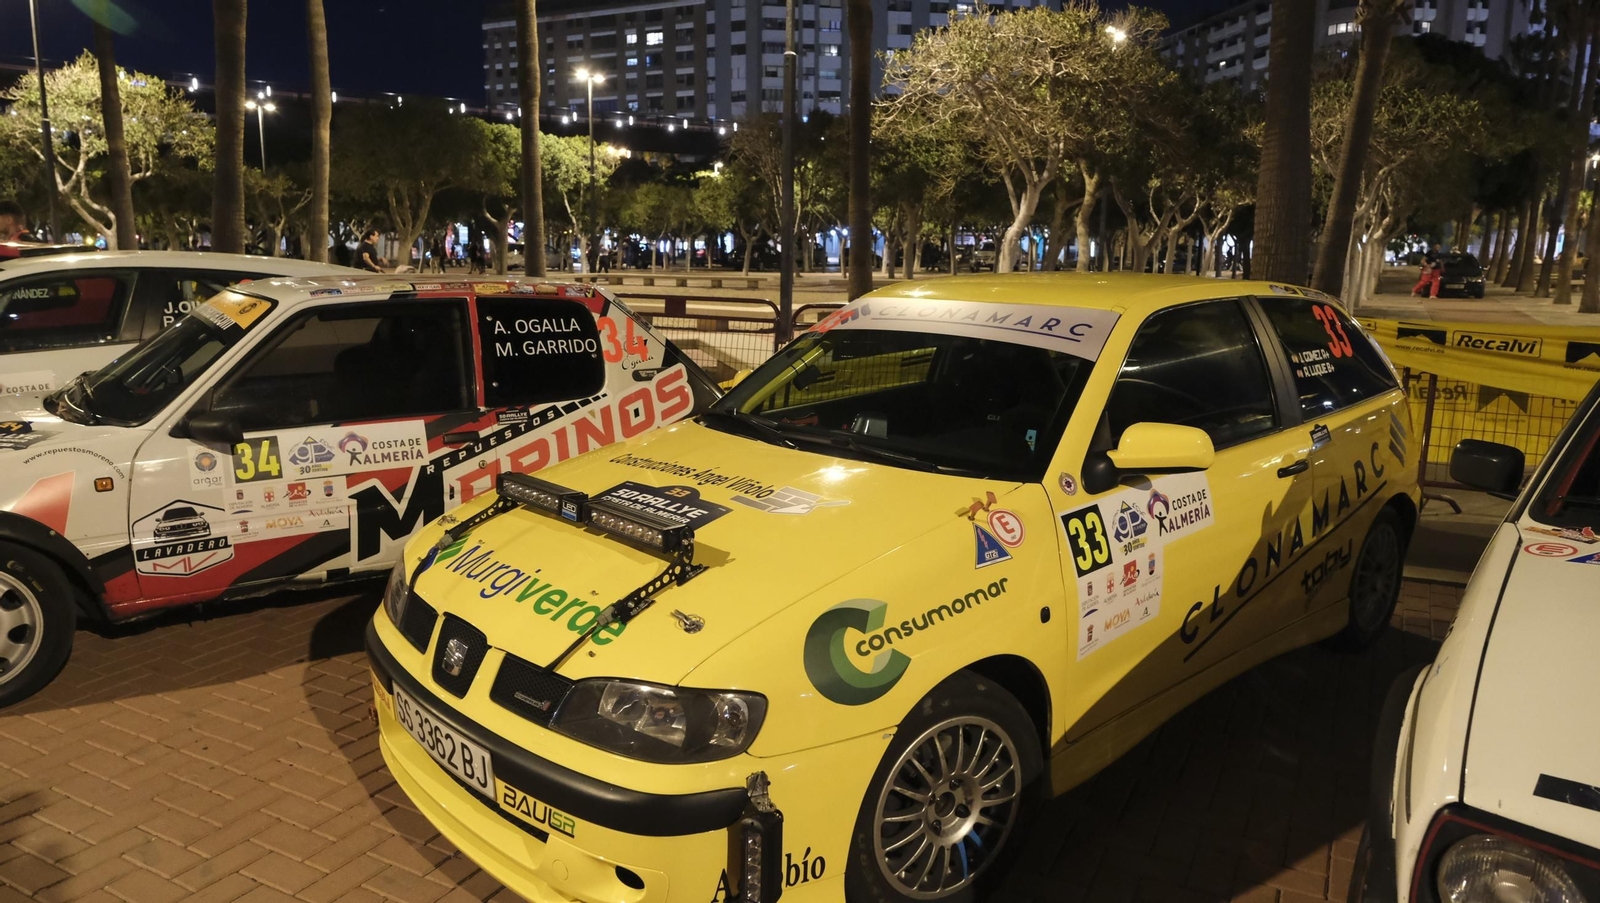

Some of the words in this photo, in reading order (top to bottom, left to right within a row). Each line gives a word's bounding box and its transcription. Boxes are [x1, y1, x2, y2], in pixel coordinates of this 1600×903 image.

[494, 320, 511, 335] A.
[515, 318, 581, 334] OGALLA
[877, 303, 1094, 337] CLONAMARC
[1312, 304, 1353, 358] 33
[495, 341, 519, 357] M.
[523, 338, 597, 356] GARRIDO
[597, 316, 649, 363] 34
[1456, 334, 1538, 355] Recalvi
[6, 384, 37, 394] COSTA
[38, 383, 50, 391] DE
[372, 440, 406, 450] COSTA
[409, 438, 422, 446] DE
[426, 410, 555, 475] REPUESTOS
[23, 447, 125, 480] www.repuestosmoreno.com
[233, 440, 281, 480] 34
[363, 446, 424, 465] ALMERÍA
[609, 452, 698, 477] Construcciones
[193, 476, 222, 487] argar
[299, 465, 311, 475] 30
[664, 486, 692, 498] 33
[1172, 494, 1198, 511] COSTA
[1197, 488, 1208, 500] DE
[561, 500, 576, 513] LED
[636, 491, 710, 519] RALLYE
[265, 516, 304, 529] MOVA
[1168, 500, 1212, 534] ALMERÍA
[143, 538, 227, 559] LAVADERO
[1067, 511, 1110, 571] 33
[1123, 541, 1133, 556] 30
[1179, 441, 1385, 644] CLONAMARC
[855, 576, 1009, 657] consumomar
[1103, 608, 1131, 632] MOVA
[396, 690, 414, 732] SS
[414, 709, 459, 771] 3362
[459, 741, 488, 789] BJ
